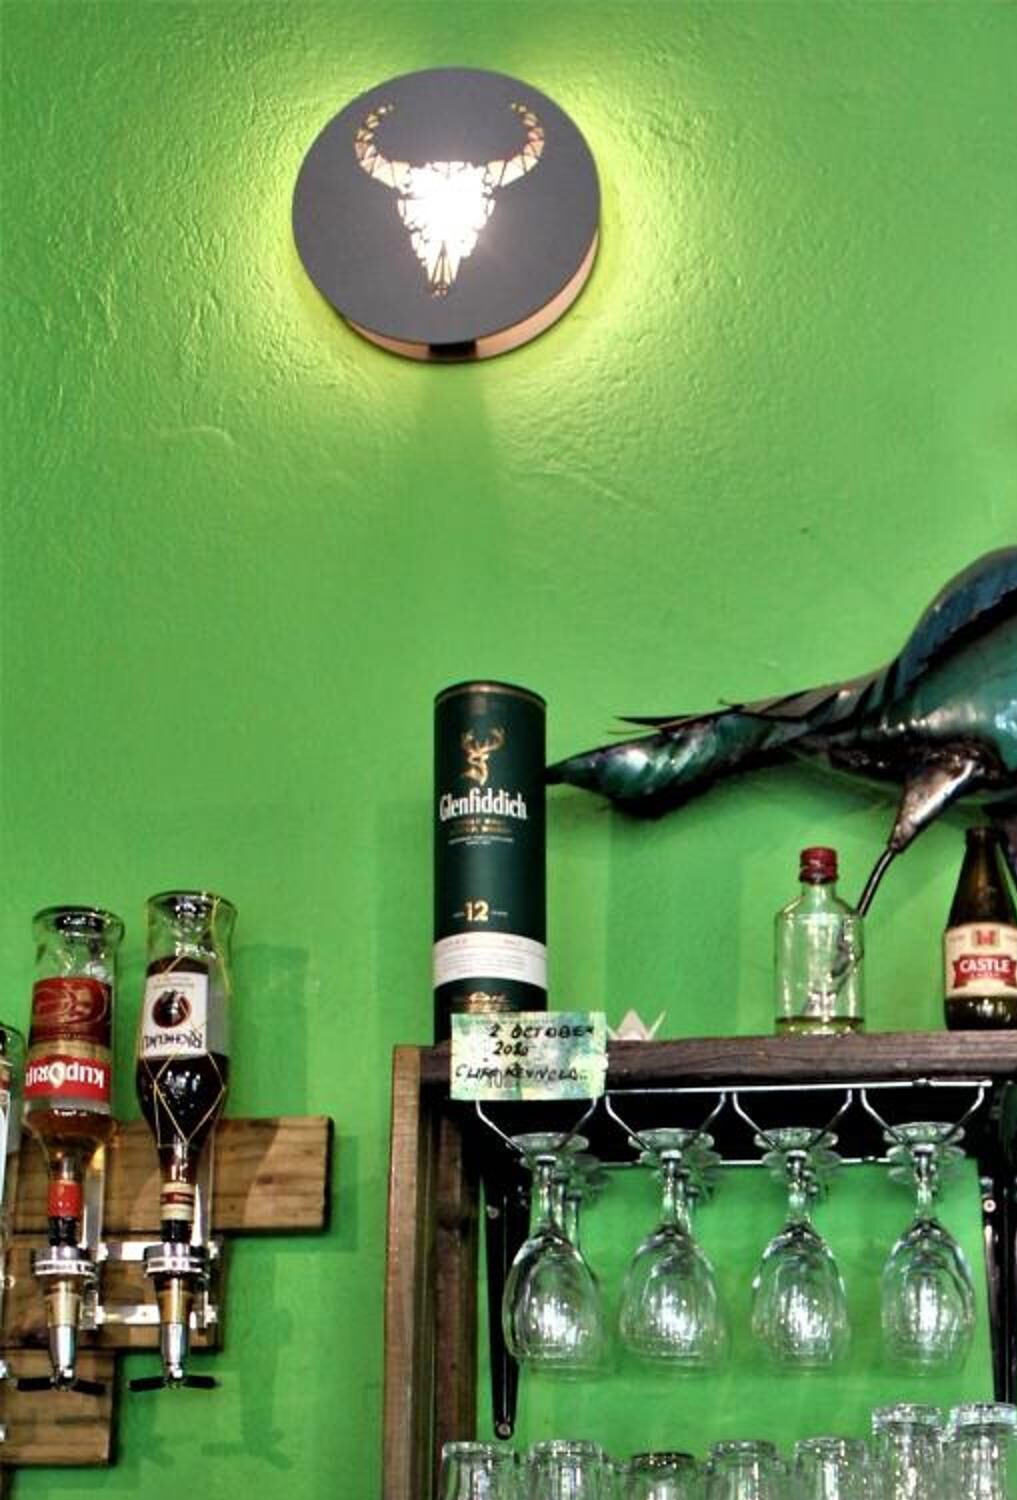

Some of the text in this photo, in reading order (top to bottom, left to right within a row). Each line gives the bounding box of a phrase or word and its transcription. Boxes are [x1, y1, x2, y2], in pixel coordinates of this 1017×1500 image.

[439, 787, 528, 821] Glenfiddich
[464, 900, 490, 923] 12
[958, 958, 1011, 974] CASTLE
[489, 1022, 500, 1038] 2
